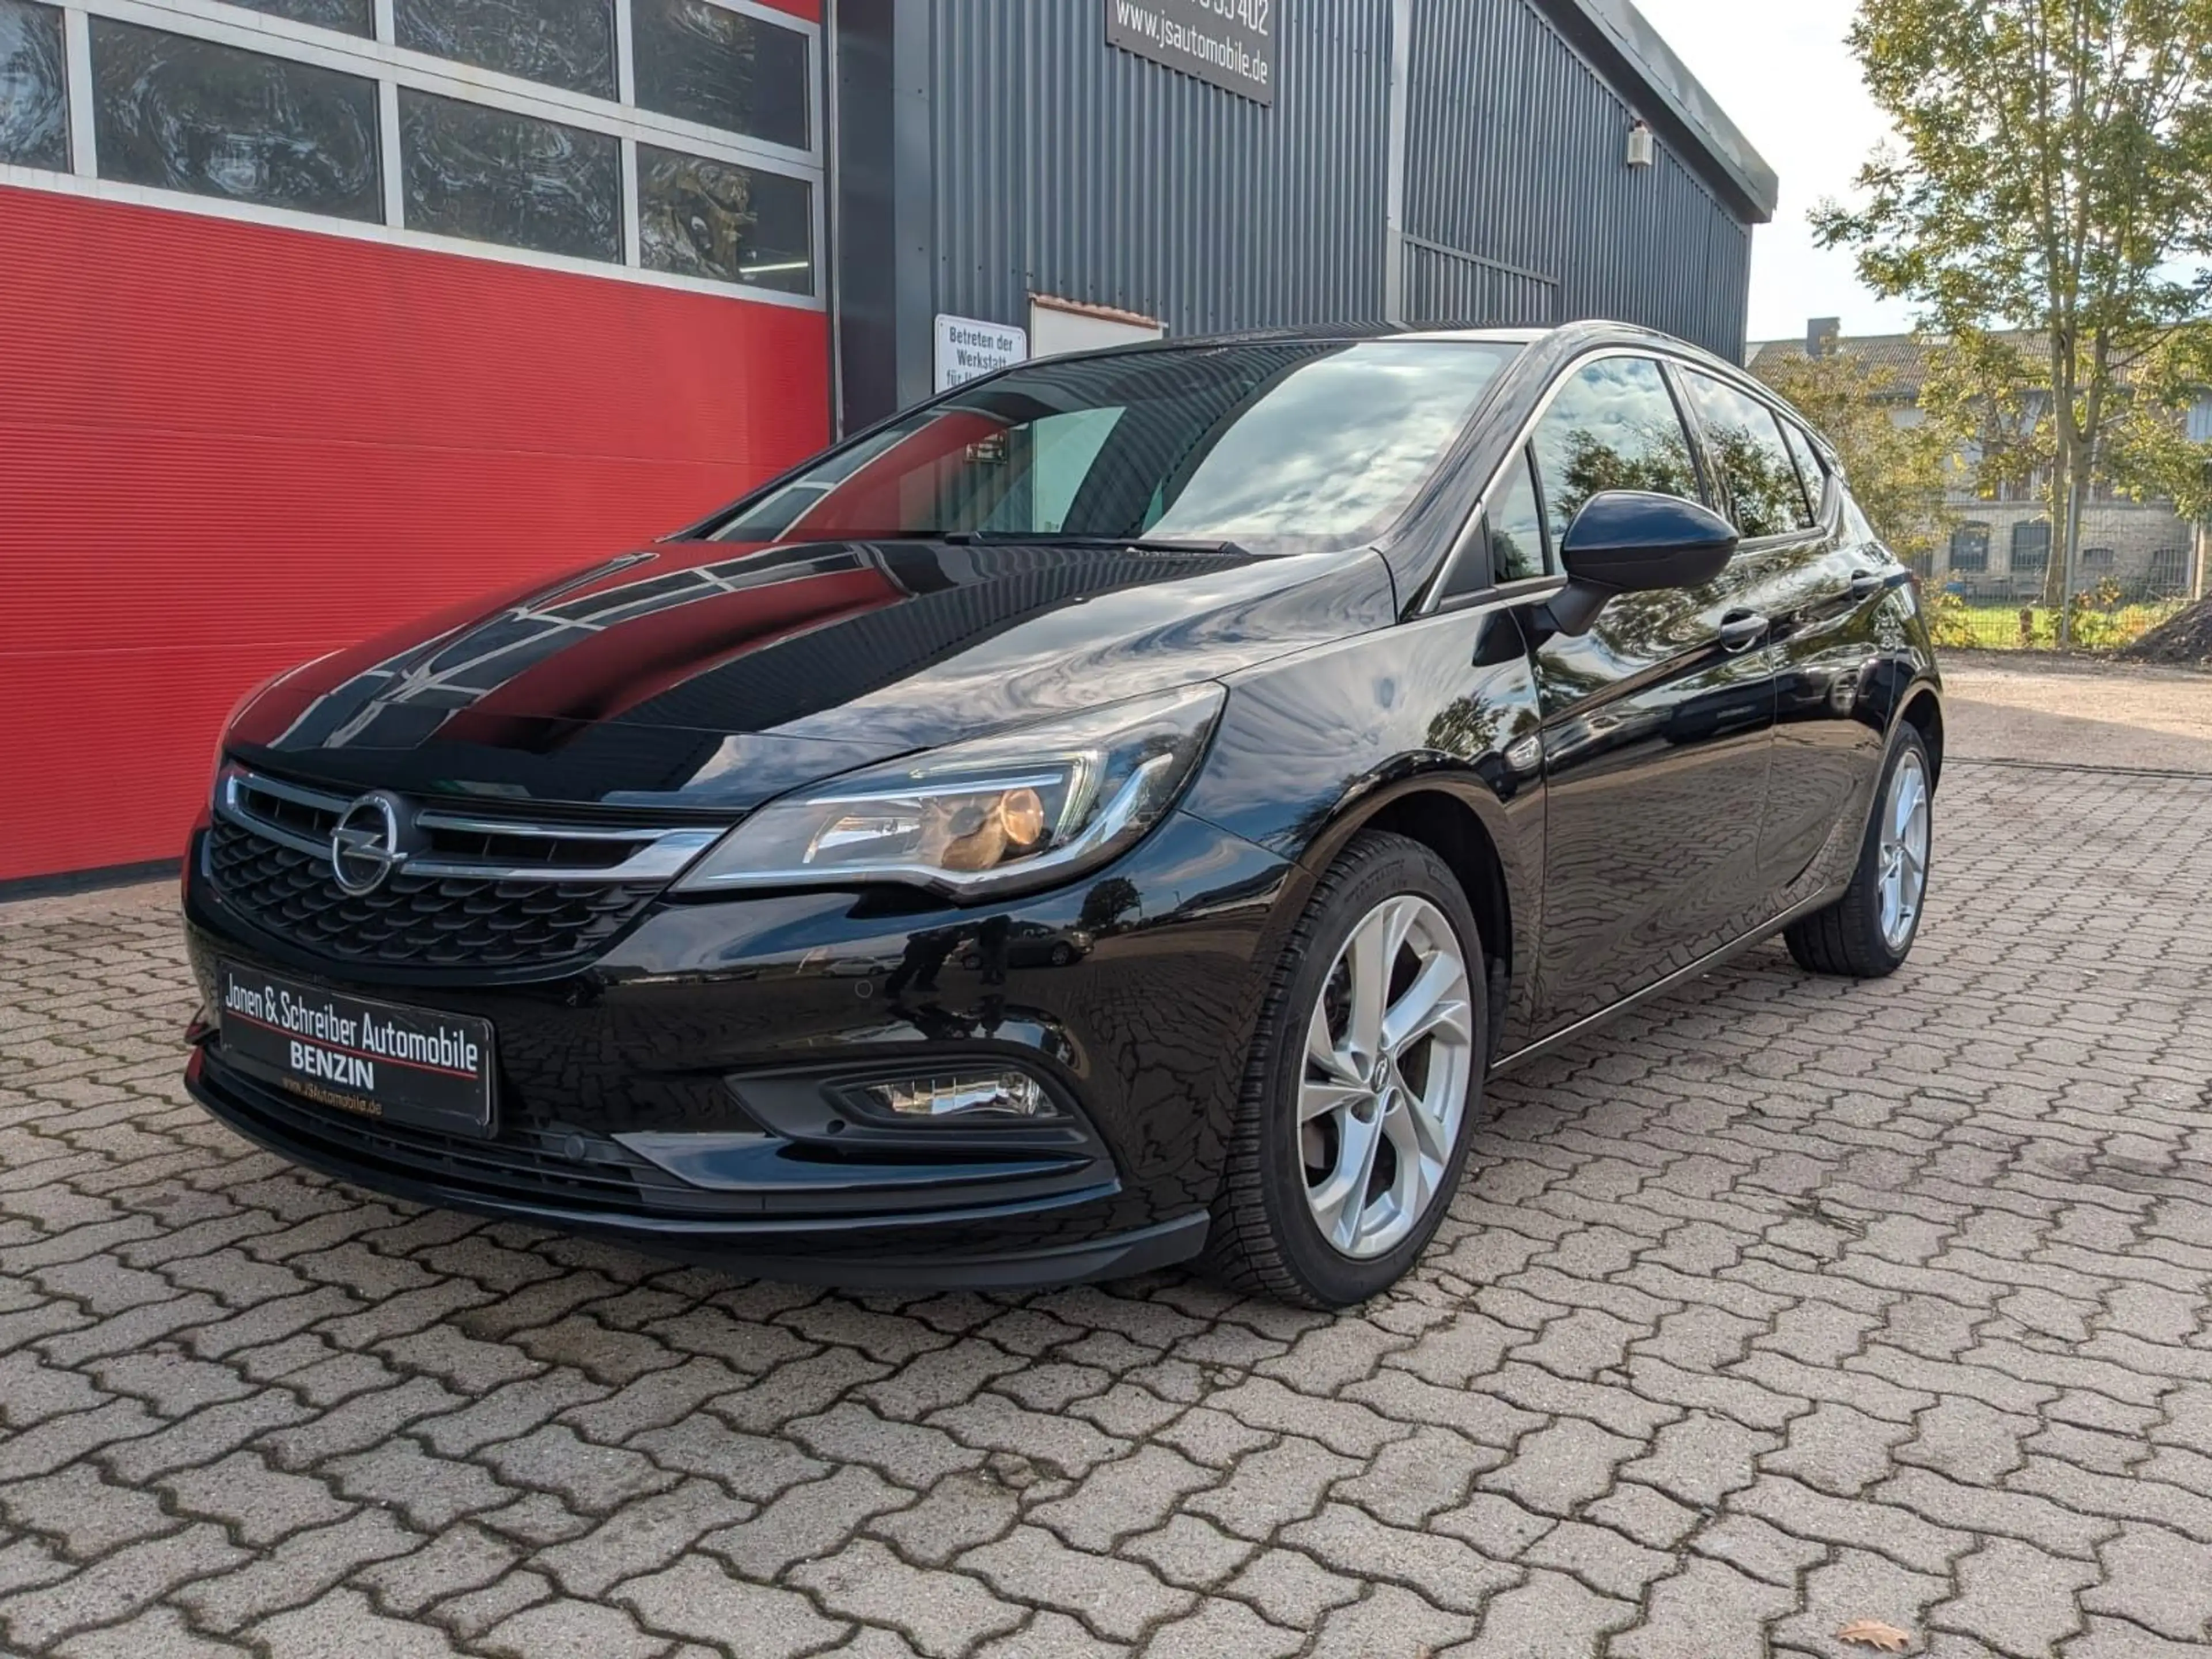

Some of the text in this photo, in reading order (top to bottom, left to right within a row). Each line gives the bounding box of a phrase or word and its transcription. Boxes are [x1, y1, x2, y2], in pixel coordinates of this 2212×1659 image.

[1116, 0, 1267, 84] www.jsautomobile.de
[949, 326, 1013, 353] Betreten der
[946, 369, 961, 387] für
[956, 349, 1006, 370] Werkstatt
[225, 973, 478, 1071] Jonen & Schreiber Automobile
[290, 1040, 374, 1090] BENZIN
